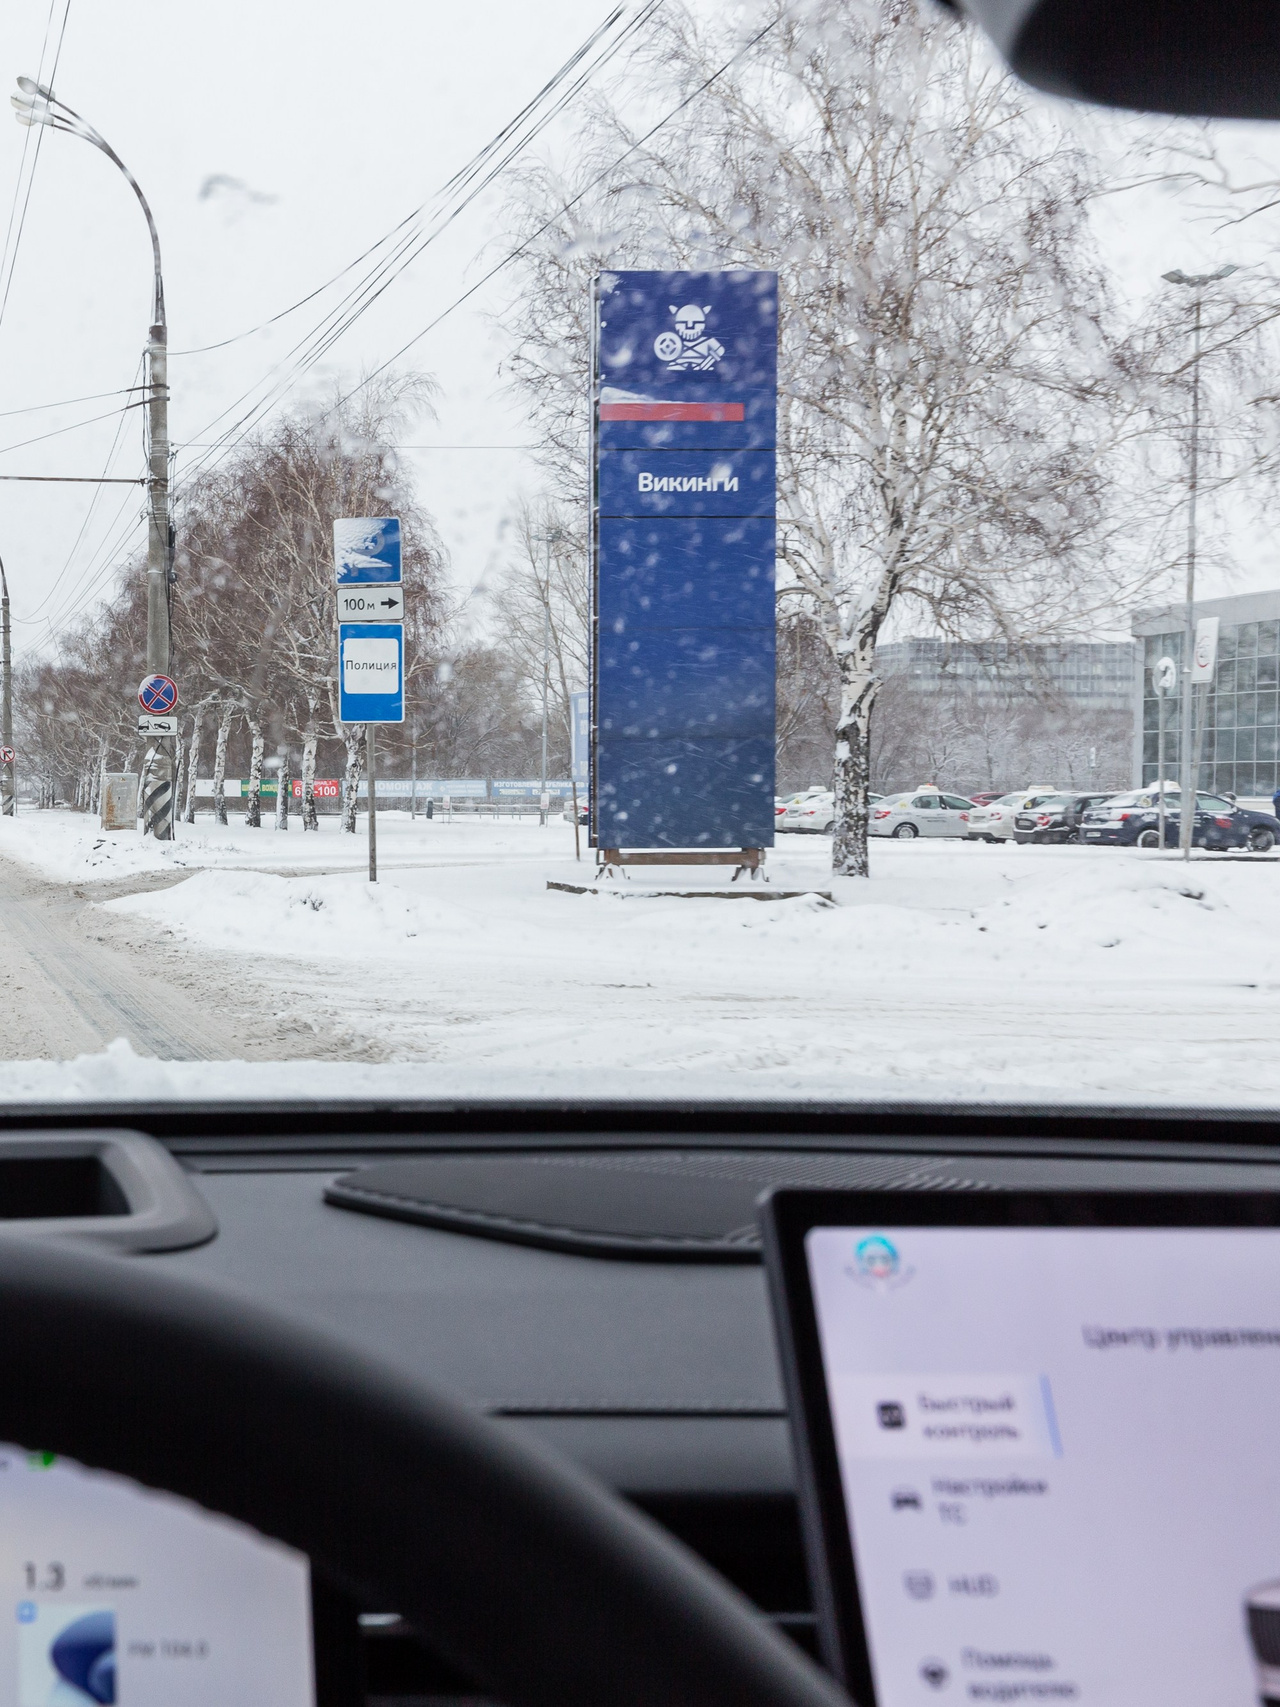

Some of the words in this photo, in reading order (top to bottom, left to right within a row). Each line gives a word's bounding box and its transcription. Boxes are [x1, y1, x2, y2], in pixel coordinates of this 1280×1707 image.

[638, 472, 739, 492] Викинги
[343, 598, 365, 611] 100
[345, 660, 397, 671] Полиция
[294, 786, 337, 796] 6-100
[356, 782, 433, 791] ИОМОНАЖ
